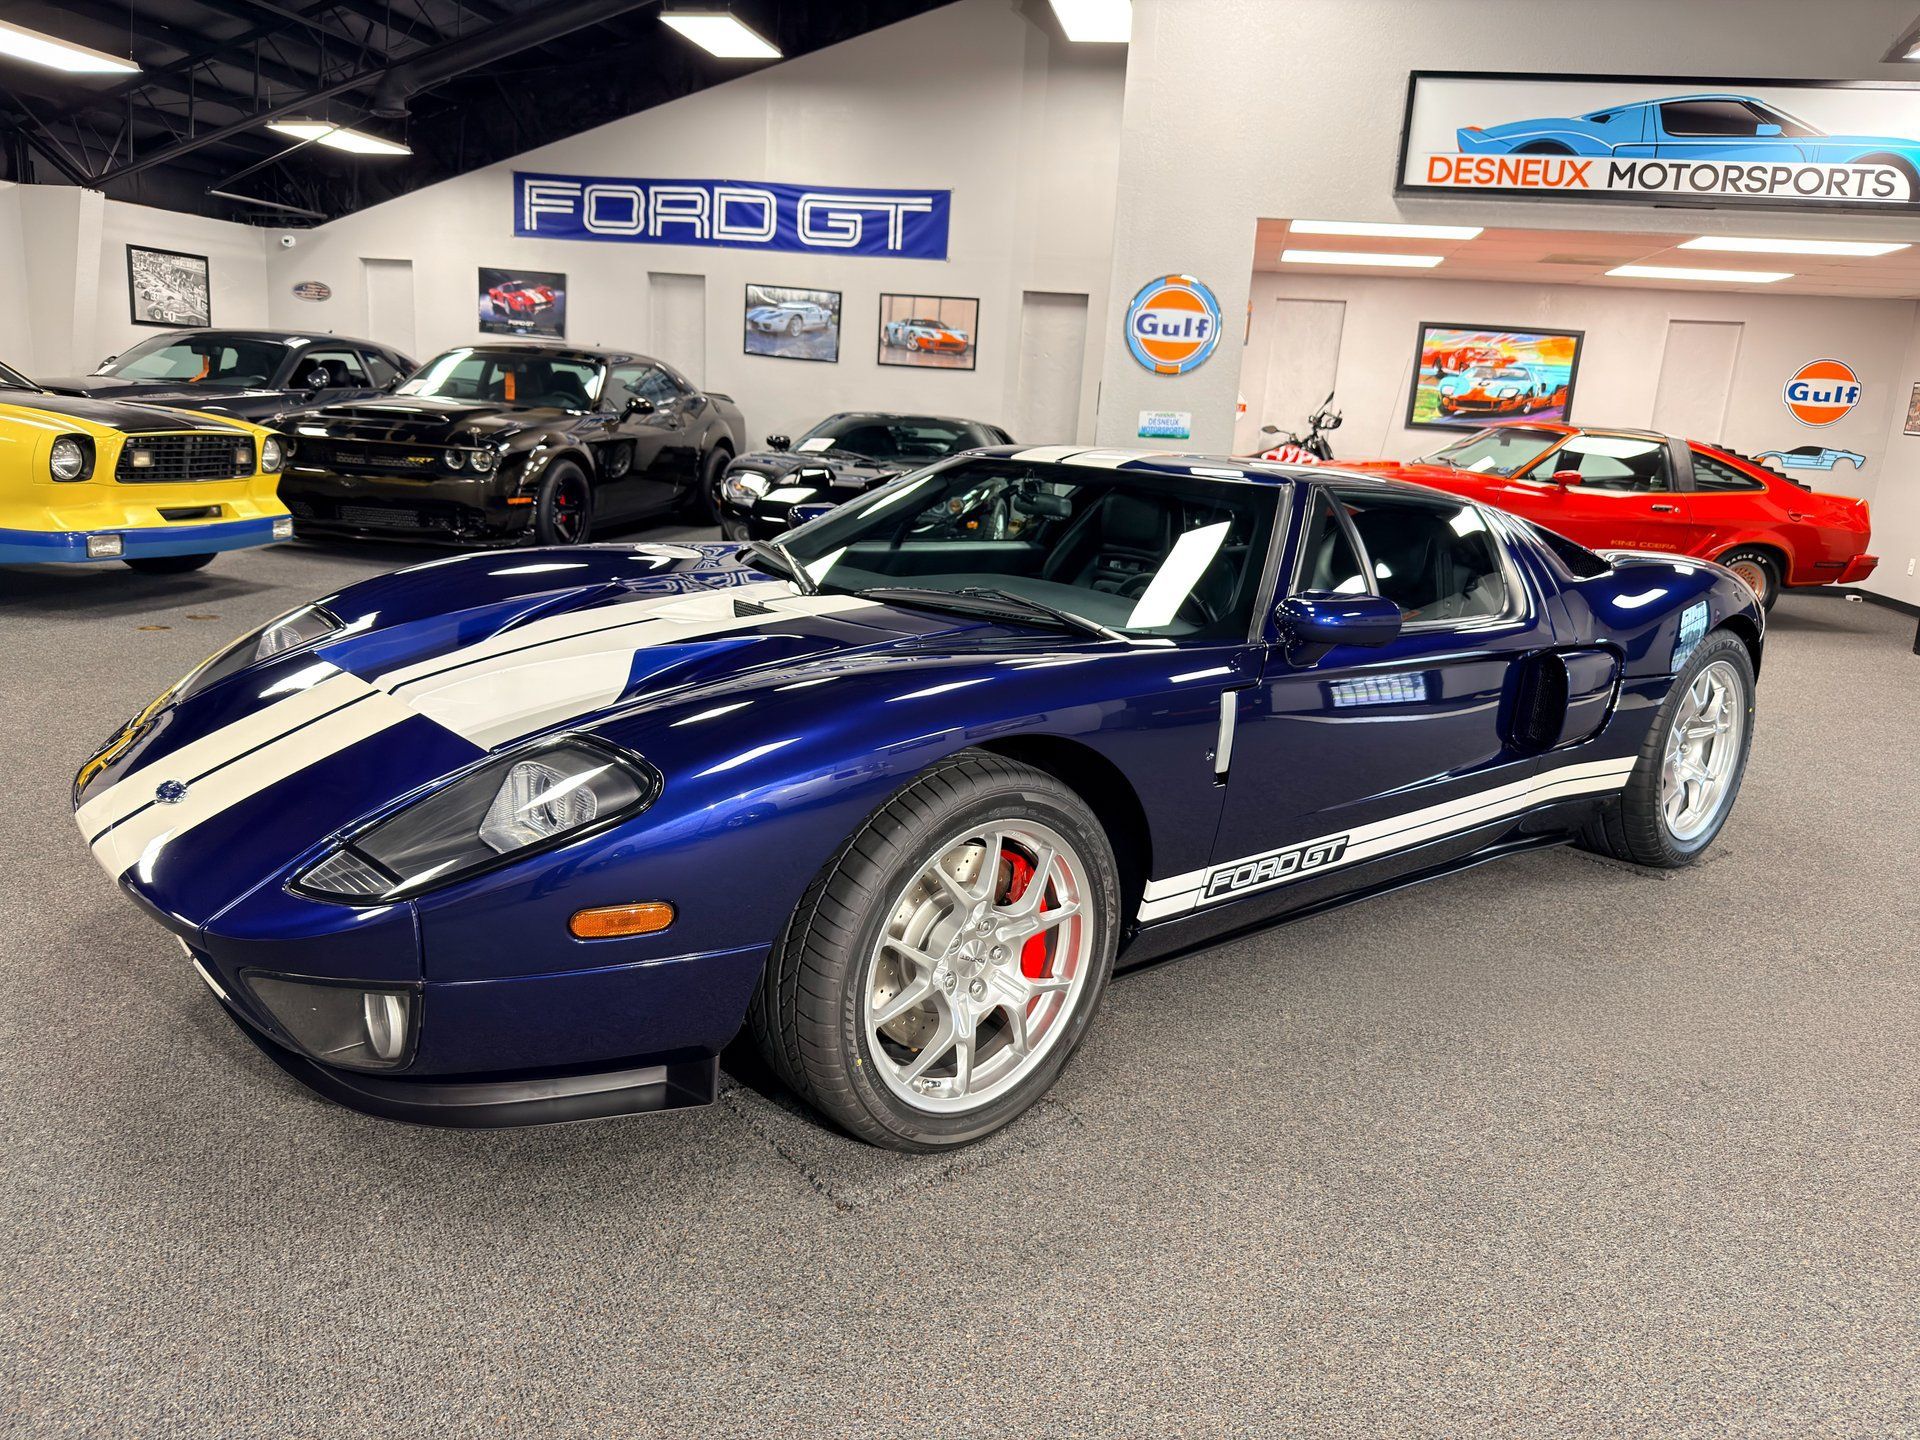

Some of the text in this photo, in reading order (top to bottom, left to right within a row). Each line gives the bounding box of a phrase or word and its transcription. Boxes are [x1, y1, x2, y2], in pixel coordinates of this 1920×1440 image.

[1427, 157, 1897, 197] DESNEUX MOTORSPORTS
[524, 179, 932, 250] FORD GT
[1136, 313, 1209, 338] Gulf
[1788, 382, 1859, 404] Gulf
[1141, 425, 1185, 435] MOTORSPORTS
[1148, 417, 1179, 426] DESNEUX
[1610, 539, 1677, 549] KING COBRA
[1725, 553, 1768, 567] EAGLE ST
[1208, 837, 1347, 896] FORD GT
